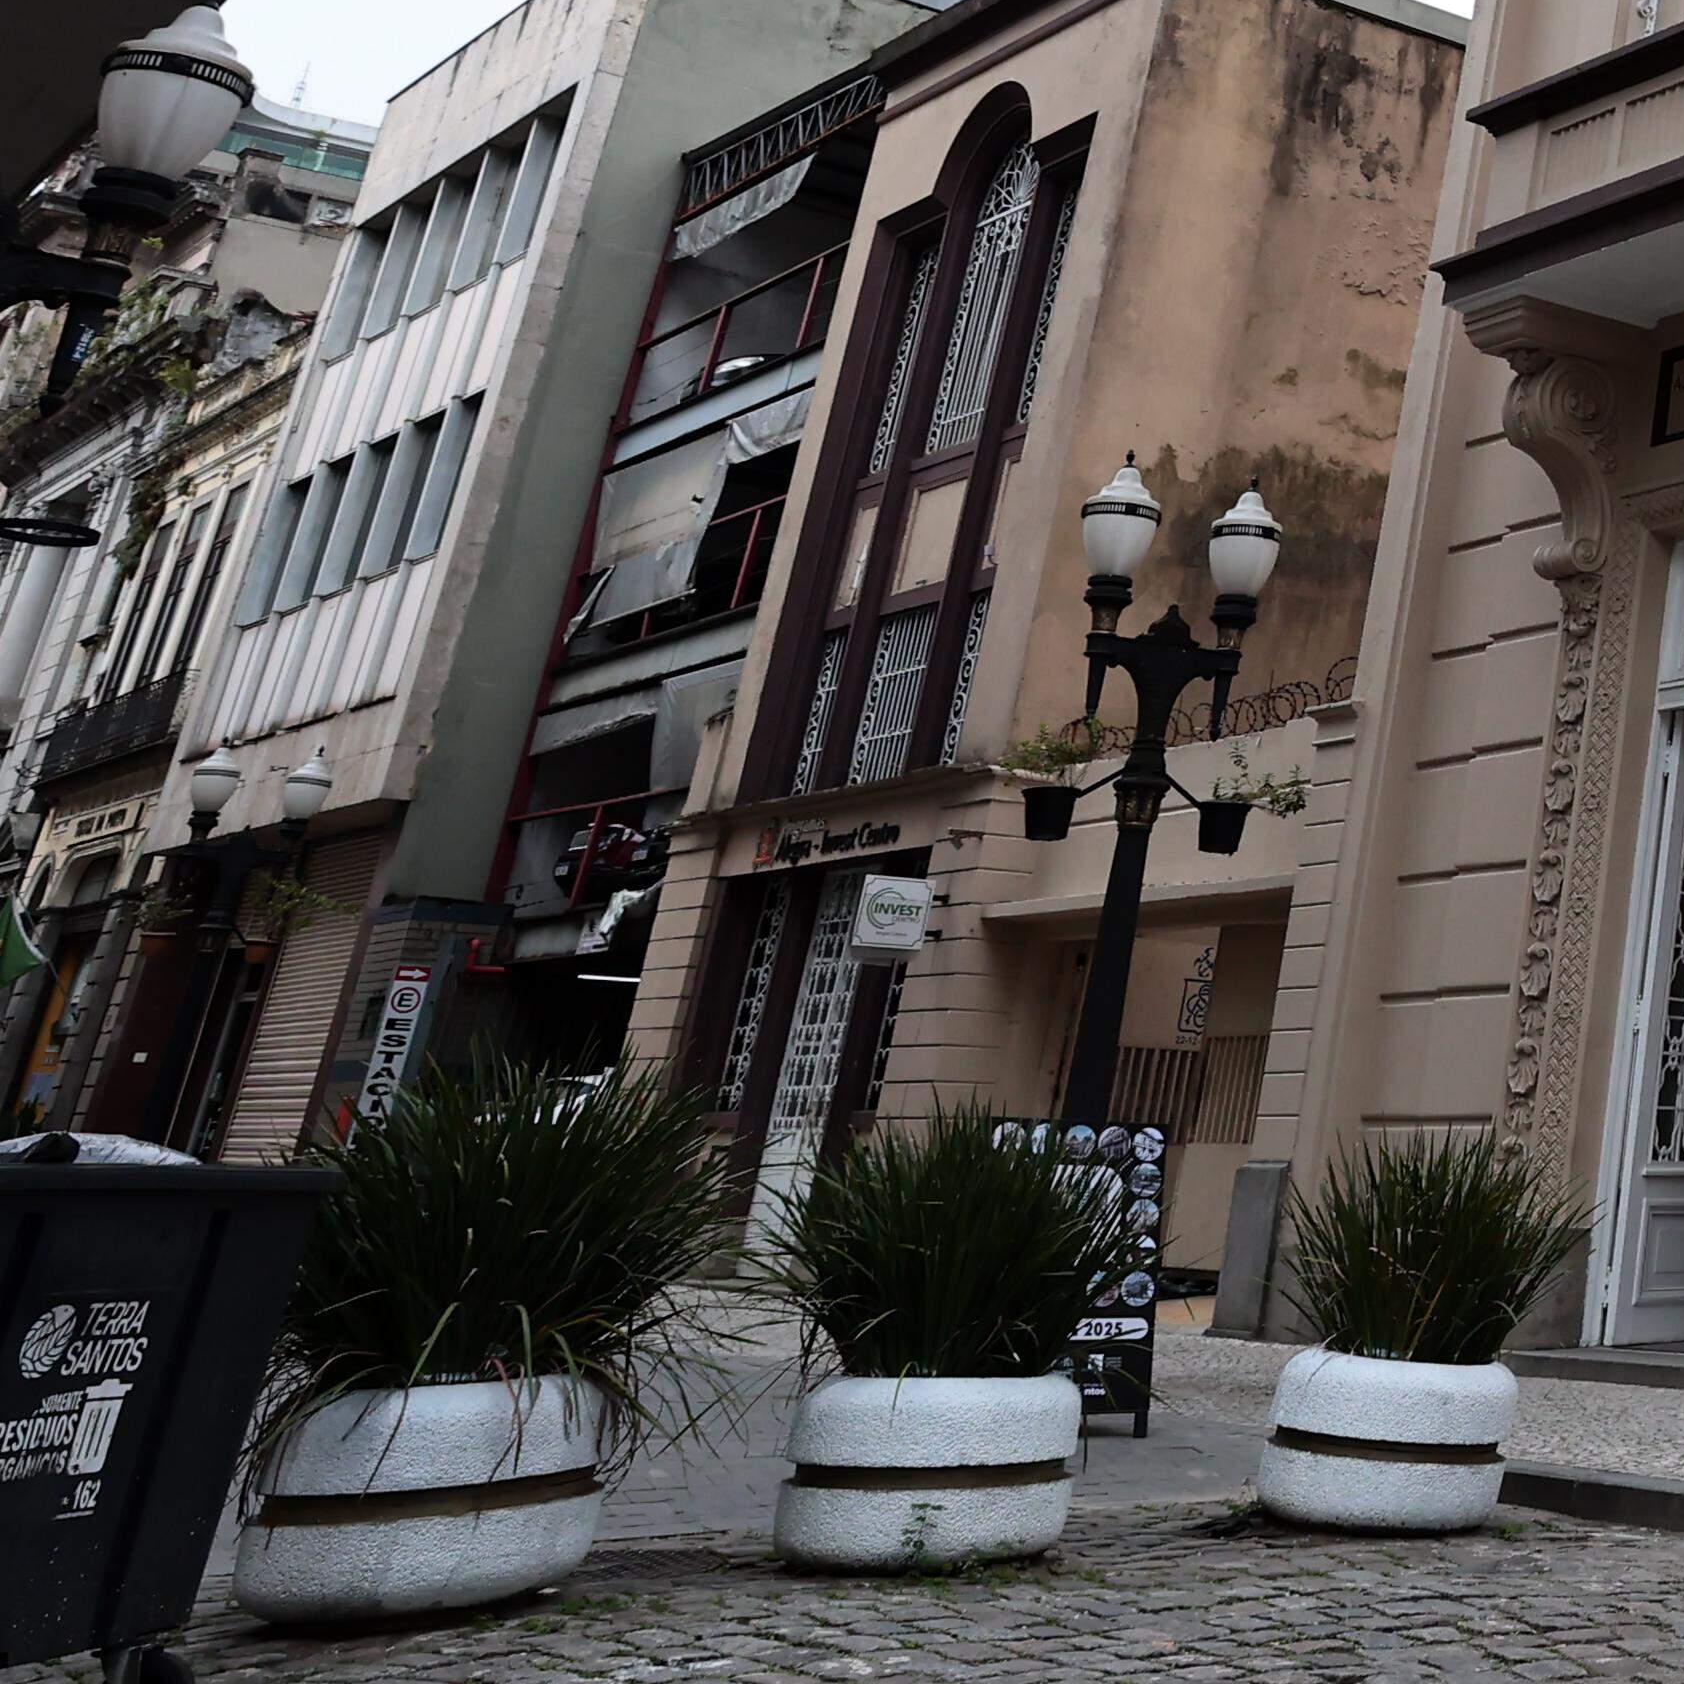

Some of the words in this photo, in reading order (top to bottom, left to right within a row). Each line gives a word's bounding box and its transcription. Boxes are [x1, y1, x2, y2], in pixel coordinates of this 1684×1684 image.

[874, 902, 923, 917] INVEST
[397, 992, 414, 1008] E
[81, 1300, 151, 1337] TERRA
[1085, 1322, 1123, 1336] 2025
[60, 1337, 149, 1377] SANTOS
[1083, 1387, 1107, 1396] ntos
[40, 1391, 84, 1414] SOMENTE
[72, 1478, 102, 1510] 162
